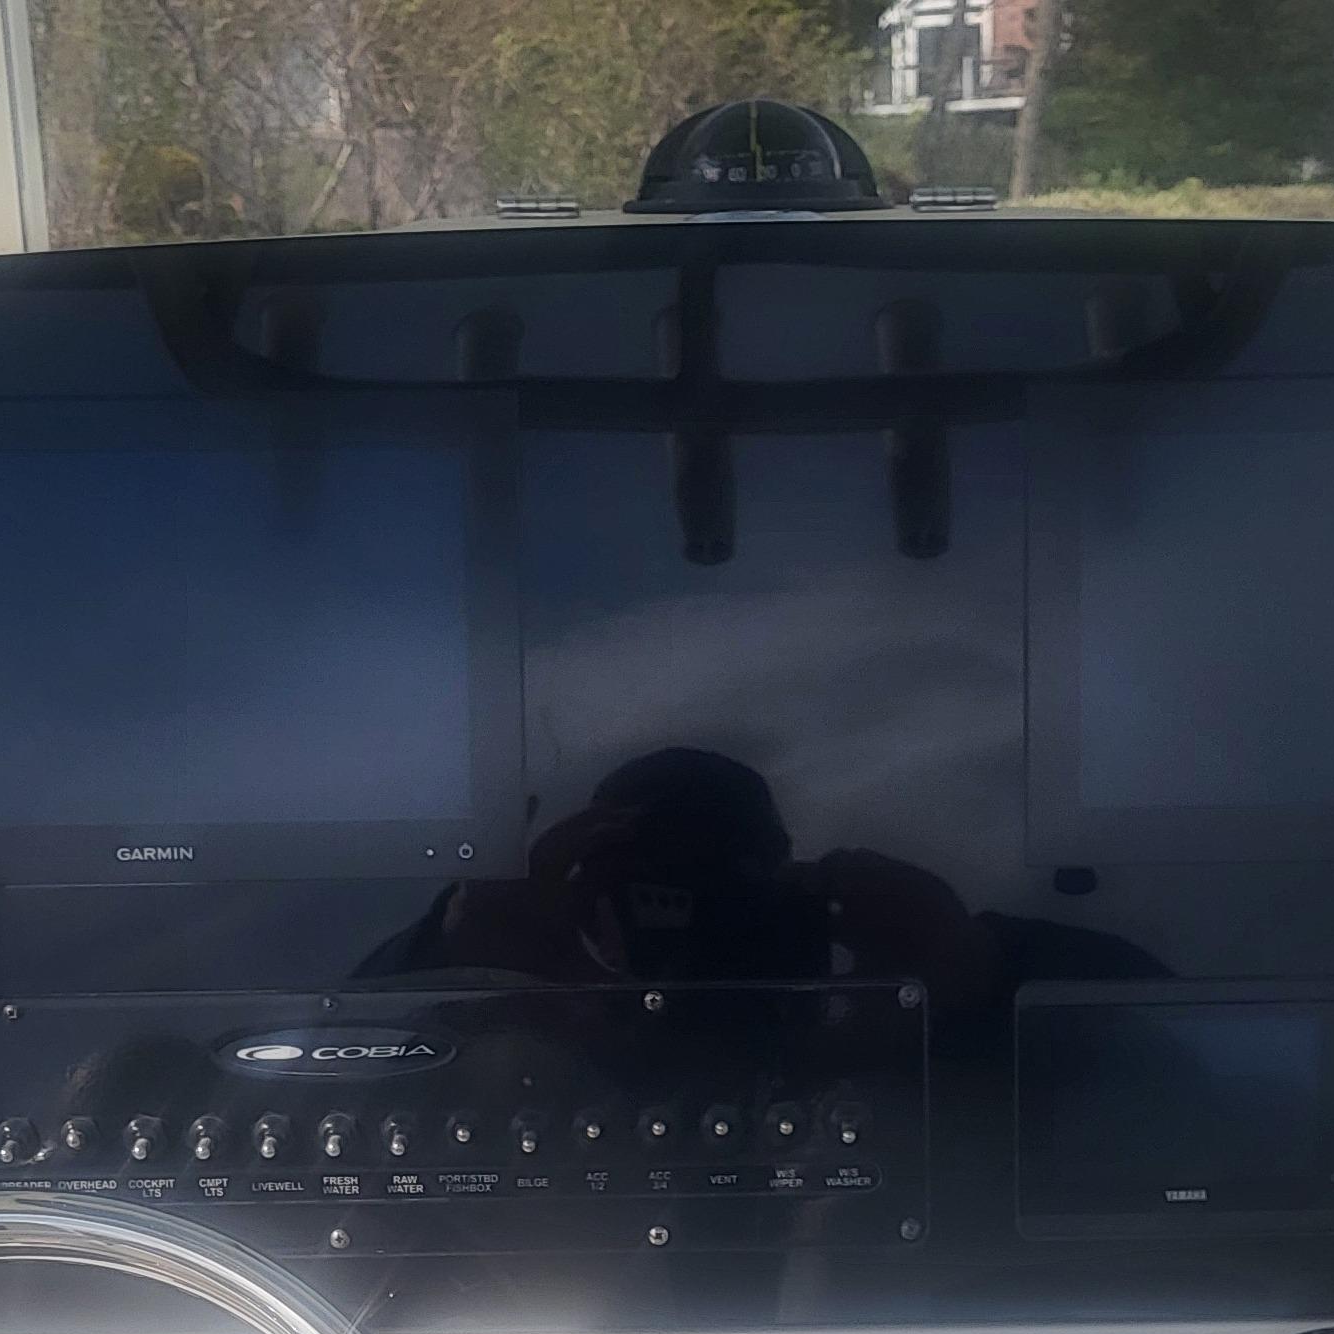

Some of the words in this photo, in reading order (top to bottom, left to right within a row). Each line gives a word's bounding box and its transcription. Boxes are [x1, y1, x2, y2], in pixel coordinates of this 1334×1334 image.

[116, 846, 194, 861] GARMIN
[311, 1044, 436, 1060] COBIA
[322, 1176, 359, 1185] FRESH
[393, 1175, 418, 1184] RAW
[586, 1172, 609, 1181] ACC
[709, 1175, 738, 1185] VENT
[825, 1176, 872, 1187] WASHER
[58, 1180, 117, 1190] OVERHEAD
[128, 1179, 176, 1189] COCKPIT
[198, 1177, 229, 1187] CMPT
[251, 1181, 305, 1192] LIVEWELL
[517, 1178, 549, 1188] BILGE
[769, 1178, 804, 1188] WIPER
[142, 1188, 162, 1198] LTS
[204, 1187, 224, 1197] LTS
[322, 1184, 360, 1195] WATER
[386, 1183, 424, 1194] WATER
[446, 1183, 493, 1193] FISHBOX
